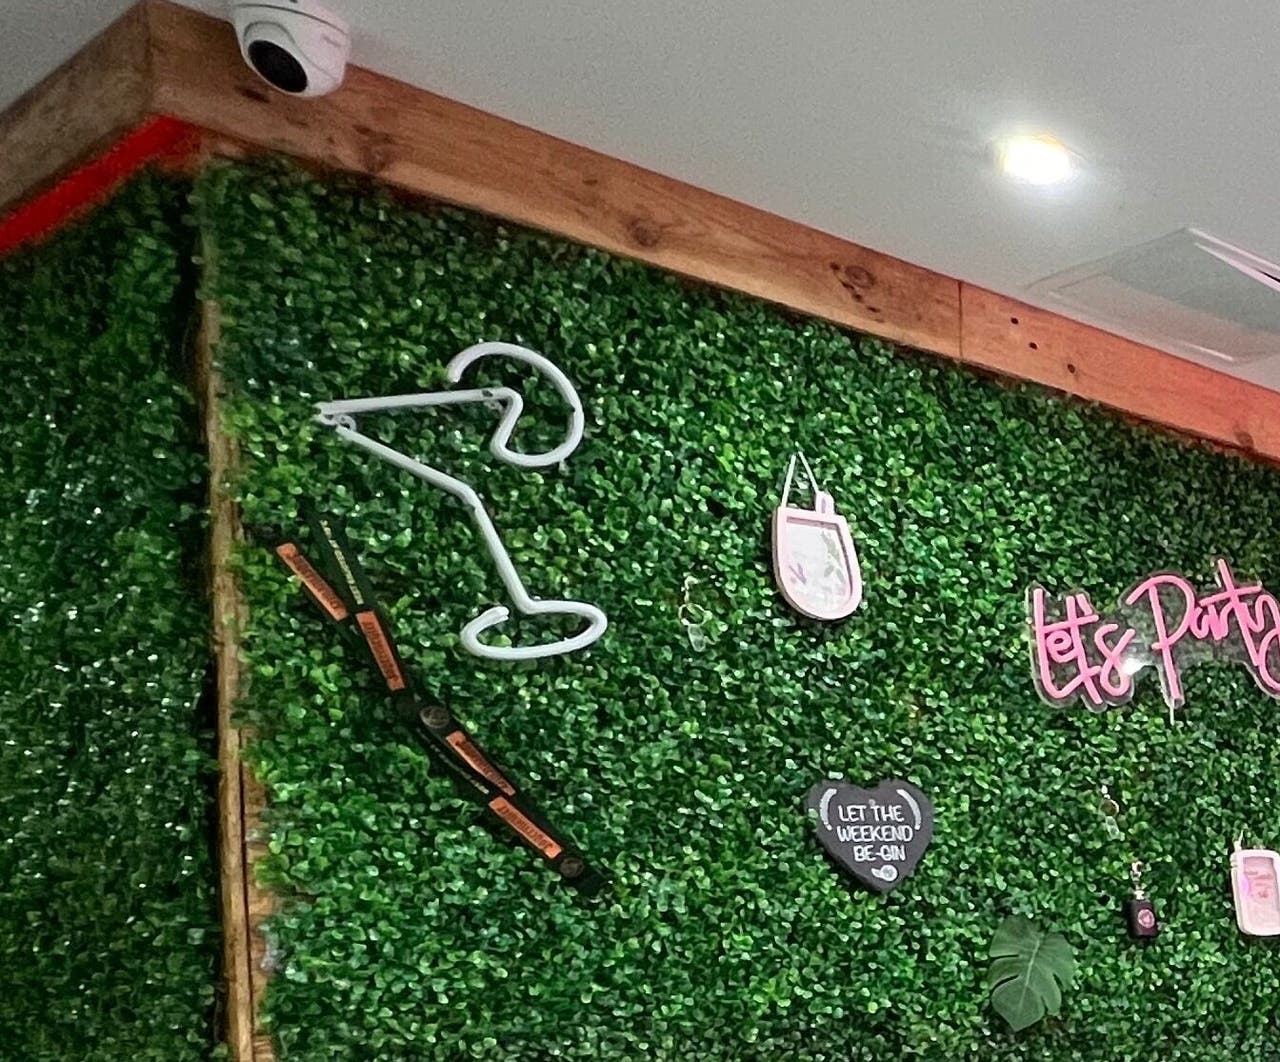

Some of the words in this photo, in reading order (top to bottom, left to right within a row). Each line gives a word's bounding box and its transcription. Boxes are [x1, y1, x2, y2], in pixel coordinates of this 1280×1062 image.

[838, 805, 867, 822] LET
[870, 805, 905, 822] THE
[836, 825, 914, 842] WEEKEND
[853, 845, 906, 861] BE-GIN
